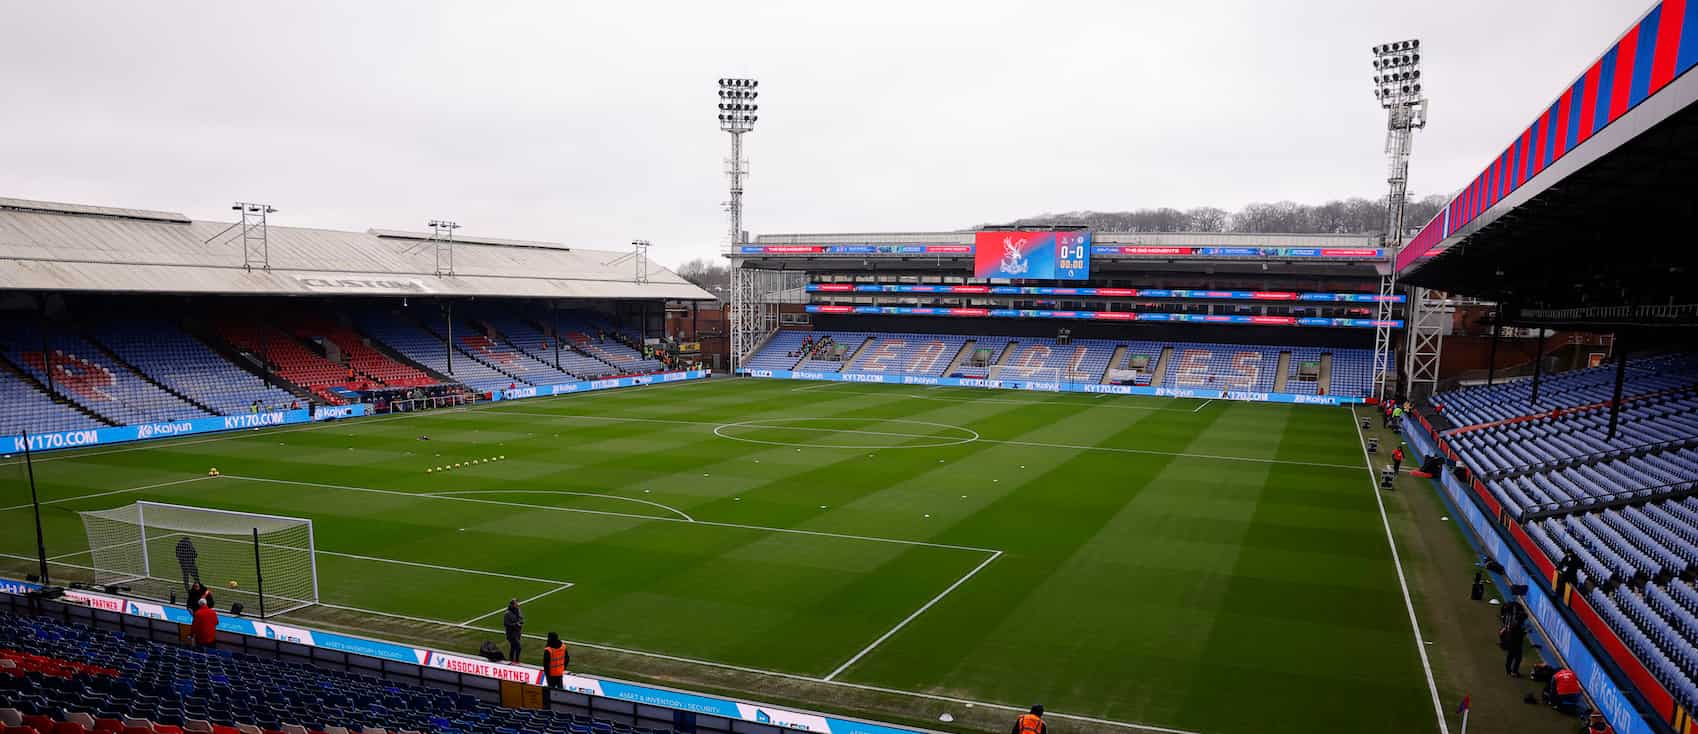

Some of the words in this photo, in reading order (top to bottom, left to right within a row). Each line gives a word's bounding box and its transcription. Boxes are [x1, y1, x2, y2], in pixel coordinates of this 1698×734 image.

[1061, 245, 1084, 259] 0-0
[1084, 384, 1131, 394] KY170.COM
[153, 421, 193, 436] Kaiyun
[225, 412, 284, 429] KY170.COM
[14, 429, 99, 451] KY170.COM
[447, 660, 489, 676] ASSOCIATE
[493, 667, 530, 683] PARTNER
